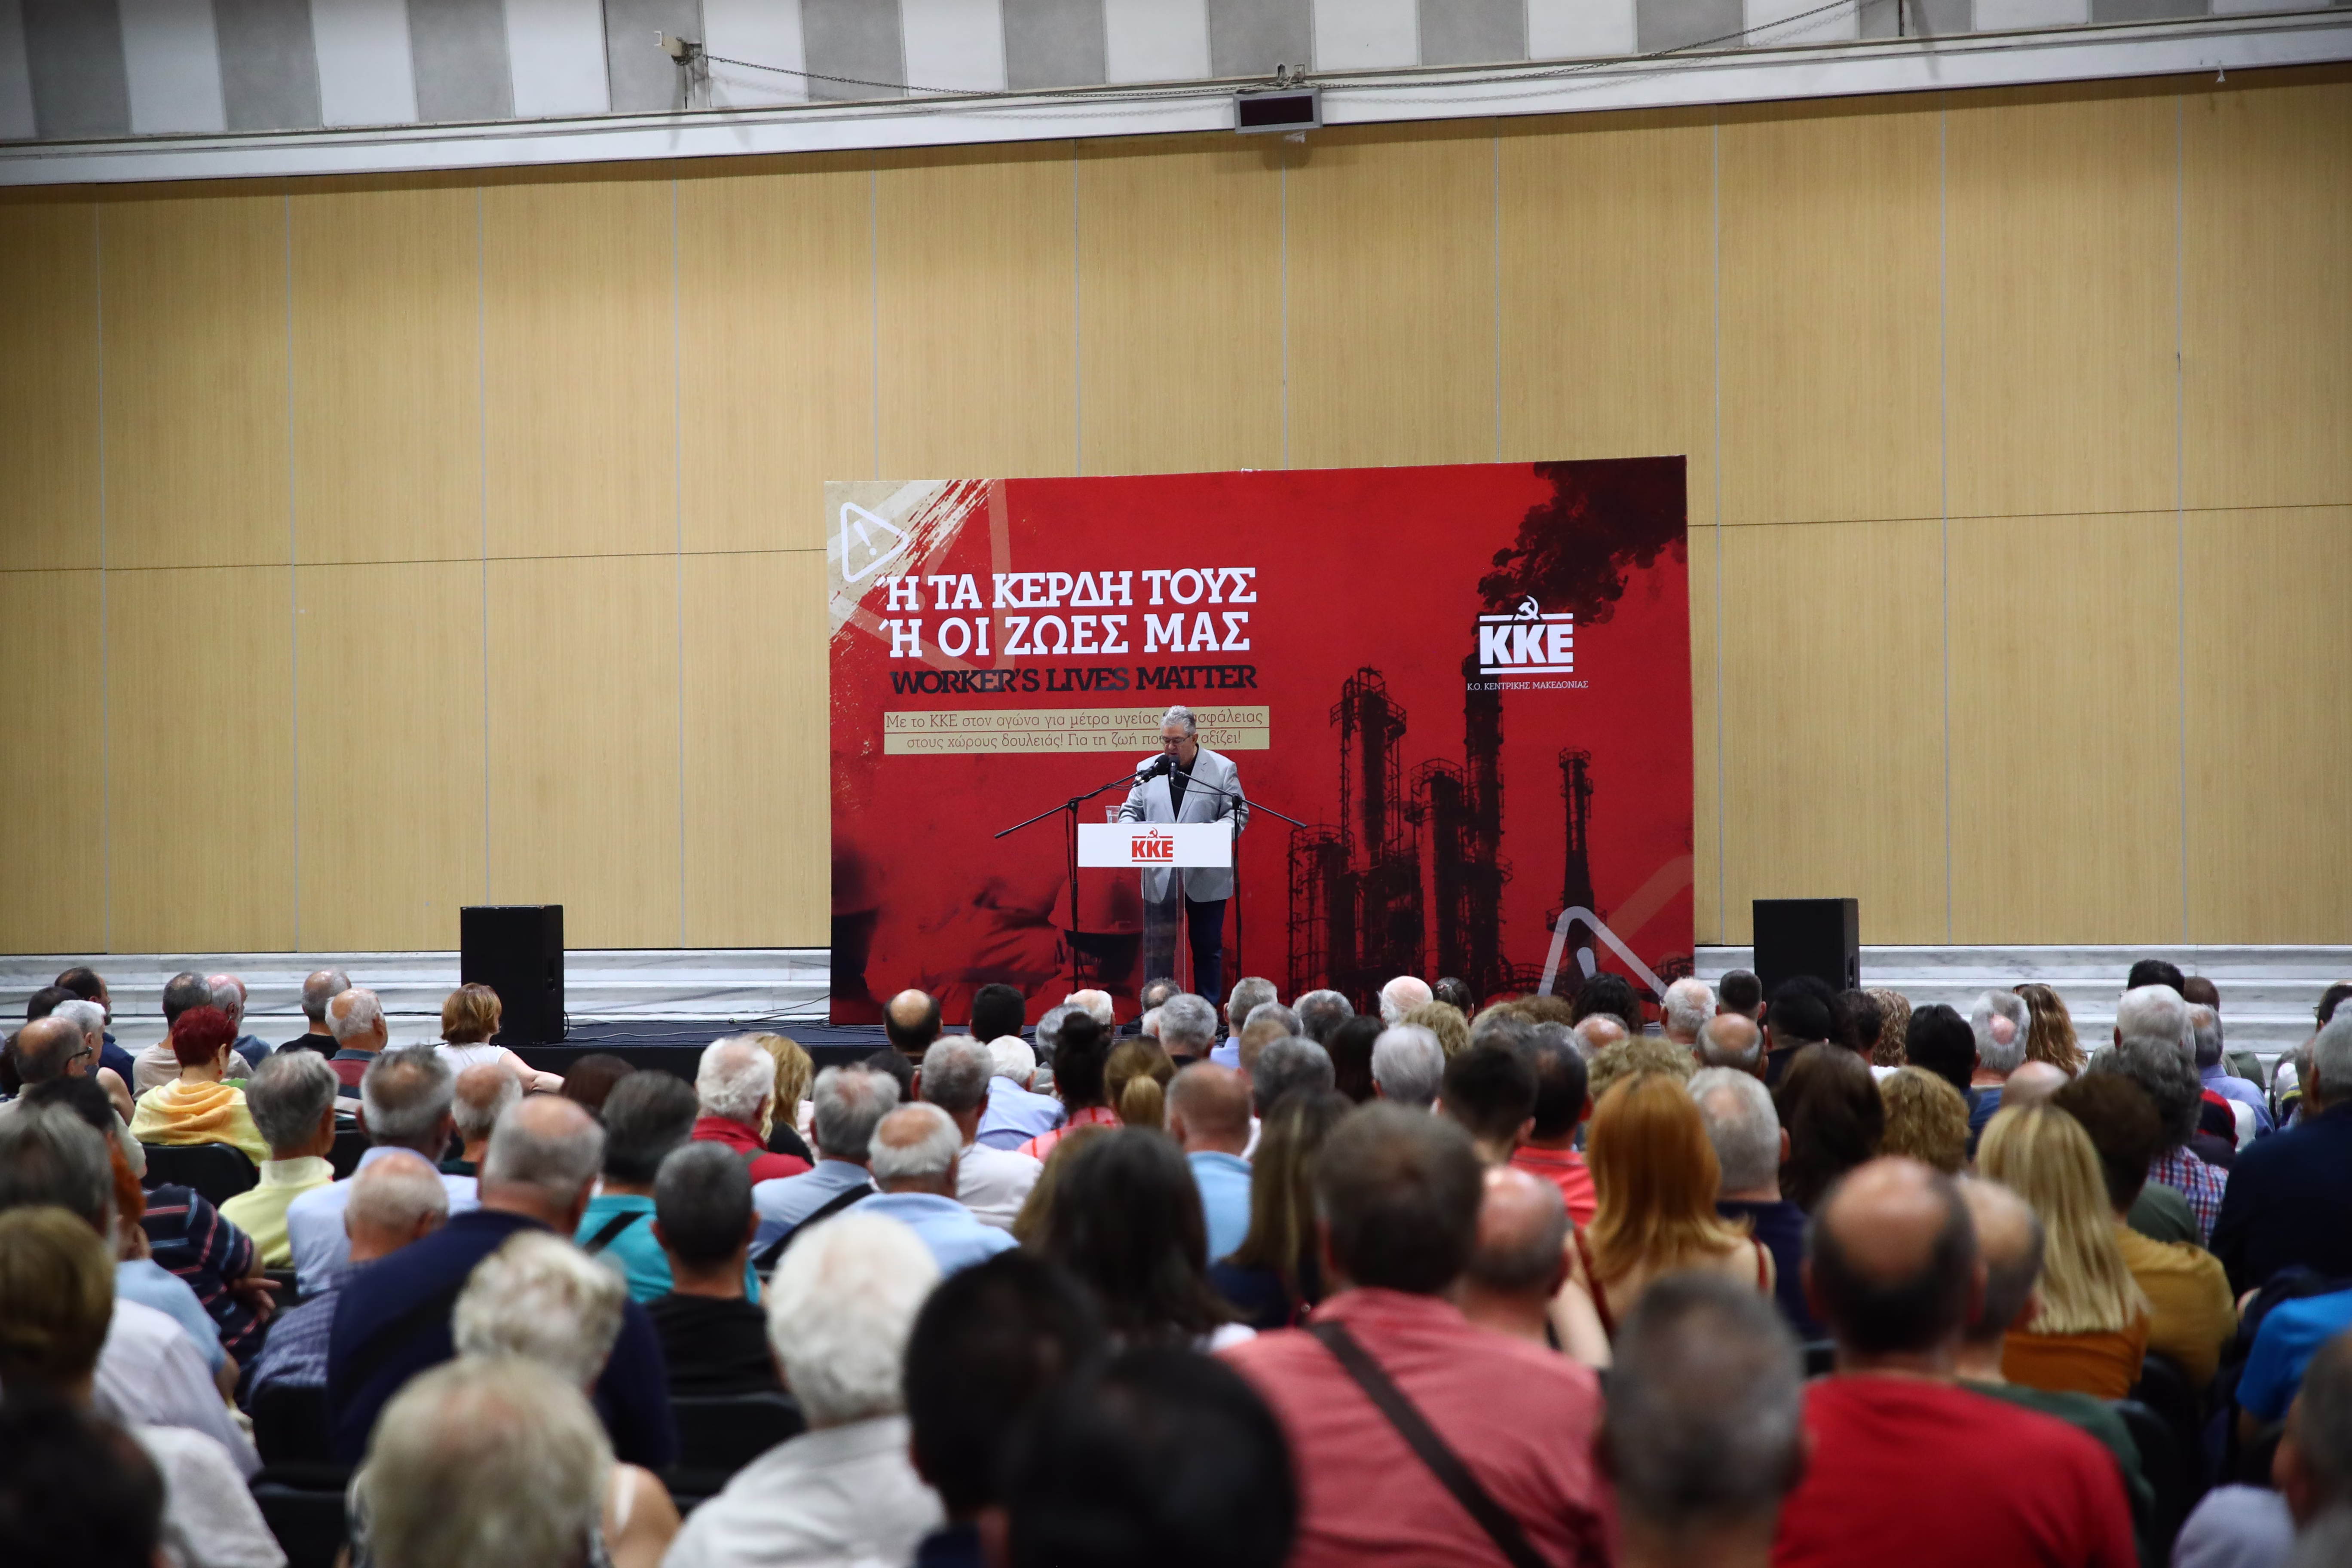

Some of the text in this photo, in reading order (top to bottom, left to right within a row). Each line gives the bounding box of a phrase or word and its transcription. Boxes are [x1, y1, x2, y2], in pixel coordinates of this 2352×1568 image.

[928, 574, 983, 609] ΤΑ
[992, 570, 1133, 608] ΚΕΡΔΗ
[1142, 567, 1257, 605] ΤΟΥΣ
[938, 617, 989, 657] ΟΙ
[1004, 615, 1128, 655] ΖΩΕΣ
[1144, 611, 1250, 652] ΜΑΣ
[1046, 667, 1130, 692] LIVES
[1136, 665, 1258, 690] MATTER
[1484, 682, 1531, 690] ΚΕΝΤΡΙΚΗΣ
[1532, 680, 1589, 689] ΜΑΚΕΔΟΝΙΑΣ
[886, 715, 906, 728] Με
[911, 718, 925, 727] το
[930, 714, 958, 727] ΚΚΕ
[962, 717, 992, 726] στον
[996, 713, 1040, 729] αγώνα
[1044, 715, 1065, 729] για
[1070, 712, 1109, 728] μέτρα
[1115, 710, 1159, 728] υγείας
[907, 738, 944, 750] στους
[947, 735, 998, 750] χώρους
[1001, 733, 1063, 748] δουλειάς!
[1068, 733, 1088, 746] Για
[1092, 736, 1107, 745] τη
[1112, 732, 1137, 747] ζωή
[1142, 735, 1164, 745] πο
